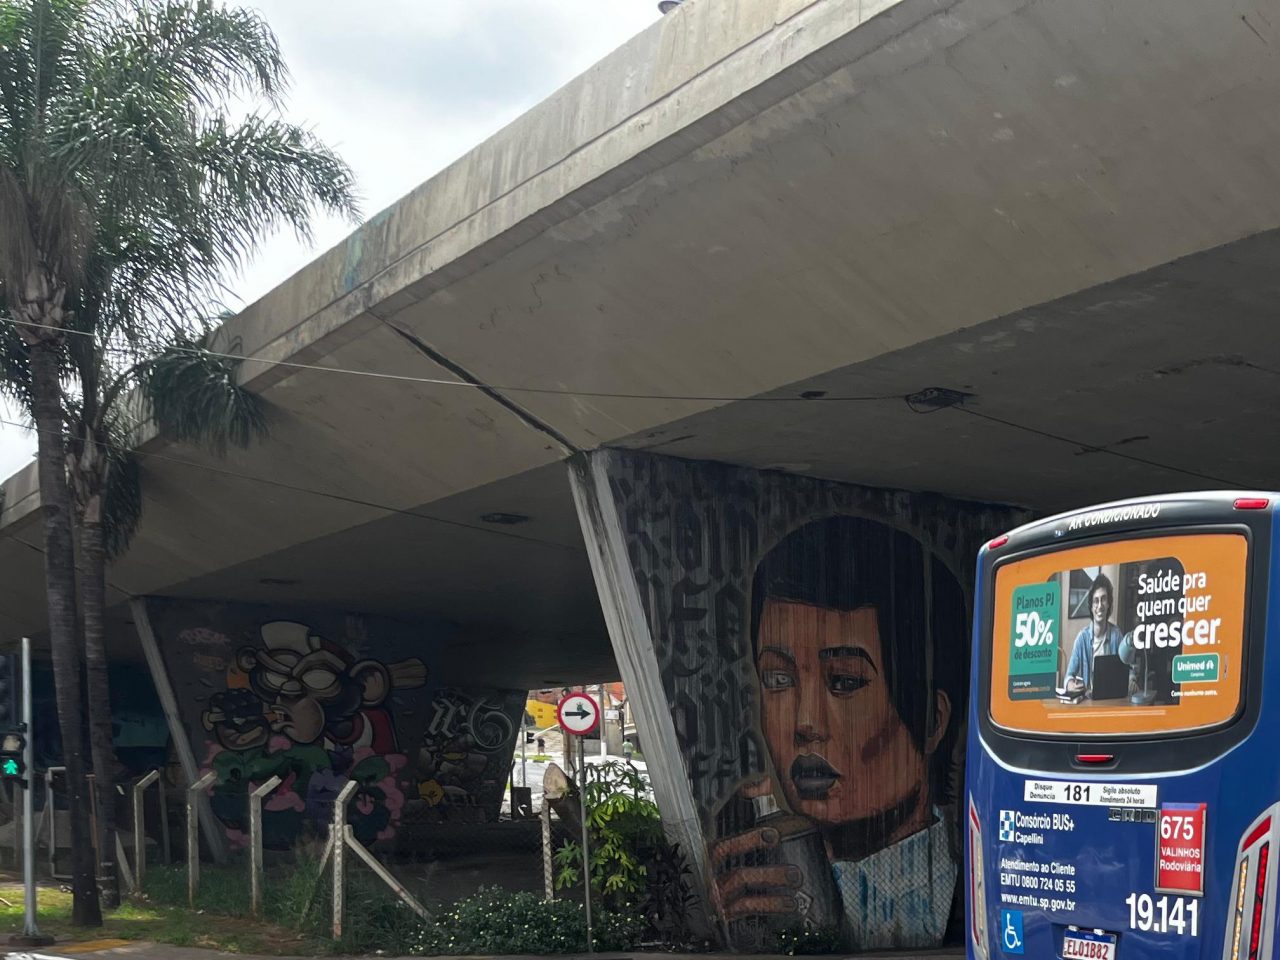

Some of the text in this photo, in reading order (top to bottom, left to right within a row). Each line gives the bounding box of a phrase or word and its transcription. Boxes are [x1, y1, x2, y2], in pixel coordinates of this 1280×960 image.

[1084, 503, 1160, 527] CONDICIONADO
[1137, 569, 1207, 595] Saúde pra
[1016, 591, 1055, 610] Planos PJ
[1136, 594, 1212, 622] quem quer
[1014, 611, 1055, 648] 50%
[1133, 618, 1221, 650] crescer.
[1014, 648, 1053, 660] de desconto
[1177, 660, 1205, 671] Unimed
[1034, 782, 1053, 792] Disque
[1063, 784, 1091, 802] 181
[1102, 786, 1141, 796] Sigilo absoluto
[1015, 810, 1075, 831] Consórcio BUS+
[1160, 815, 1195, 840] 675
[1015, 831, 1044, 846] Capellini
[1161, 846, 1200, 859] VALINHOS
[1000, 858, 1076, 876] Atendimento ao Cliente
[1160, 859, 1202, 872] Rodoviária
[1000, 872, 1076, 893] EMTU 0800 724 05 55
[1000, 893, 1076, 912] www.emtu.sp.gov.br
[1125, 892, 1198, 937] 19.141
